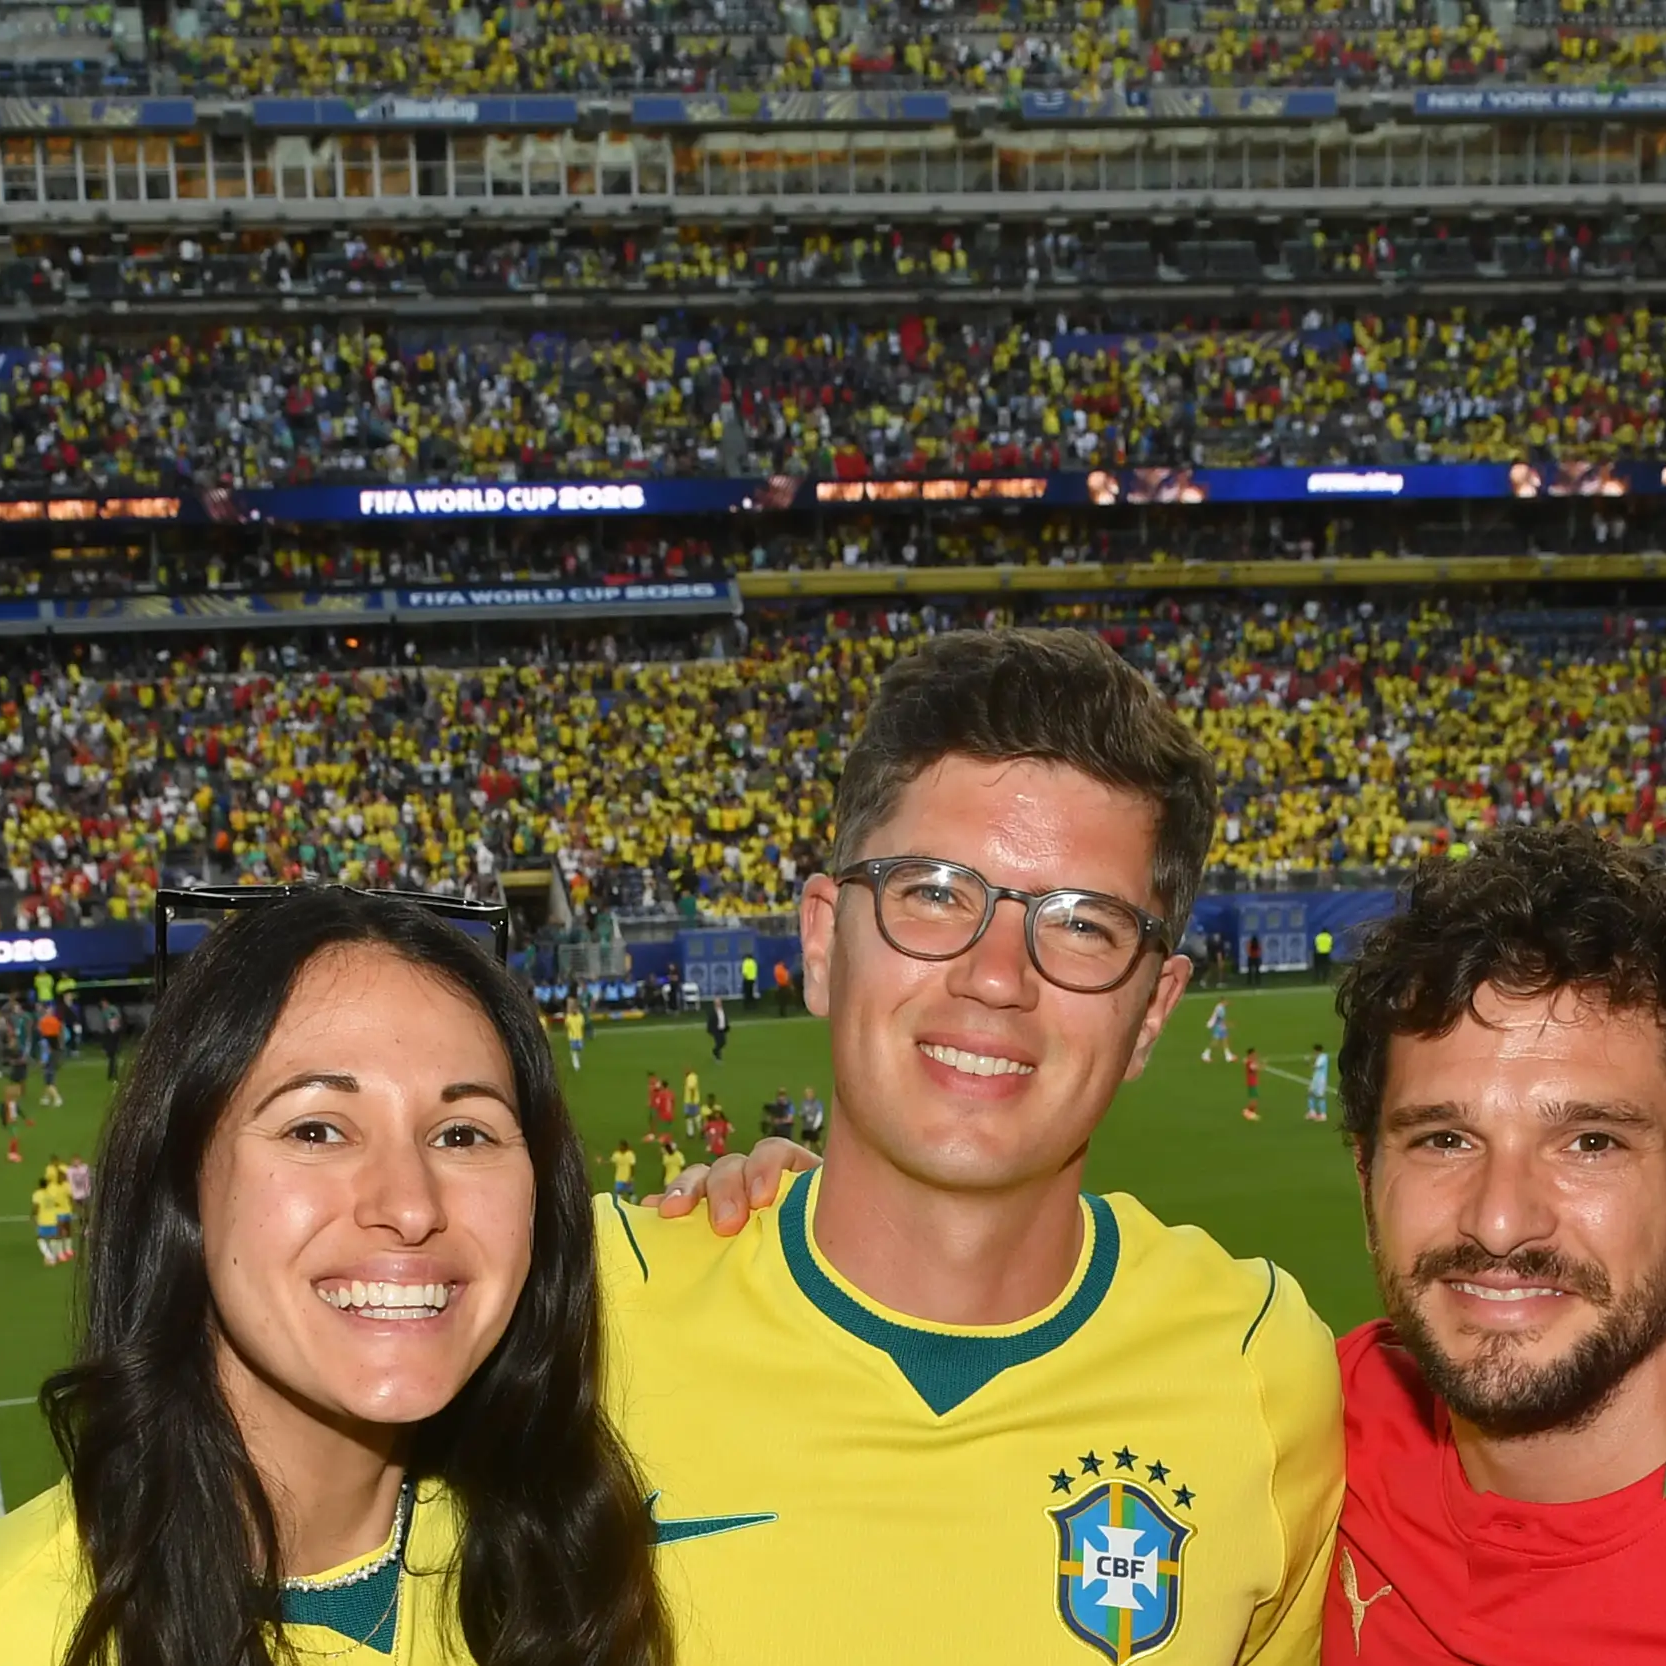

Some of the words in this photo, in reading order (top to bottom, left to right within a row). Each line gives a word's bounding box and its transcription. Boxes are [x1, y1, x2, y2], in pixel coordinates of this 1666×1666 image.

[1427, 93, 1483, 107] NEW
[1489, 92, 1551, 106] YORK
[1558, 92, 1612, 106] NEW
[360, 491, 415, 514] FIFA
[414, 488, 505, 513] WORLD
[506, 487, 558, 511] CUP
[558, 485, 645, 510] 2026
[409, 590, 469, 606] FIFA
[470, 588, 564, 604] WORLD
[569, 585, 620, 602] CUP
[626, 582, 715, 599] 2026
[1097, 1556, 1145, 1579] CBF
